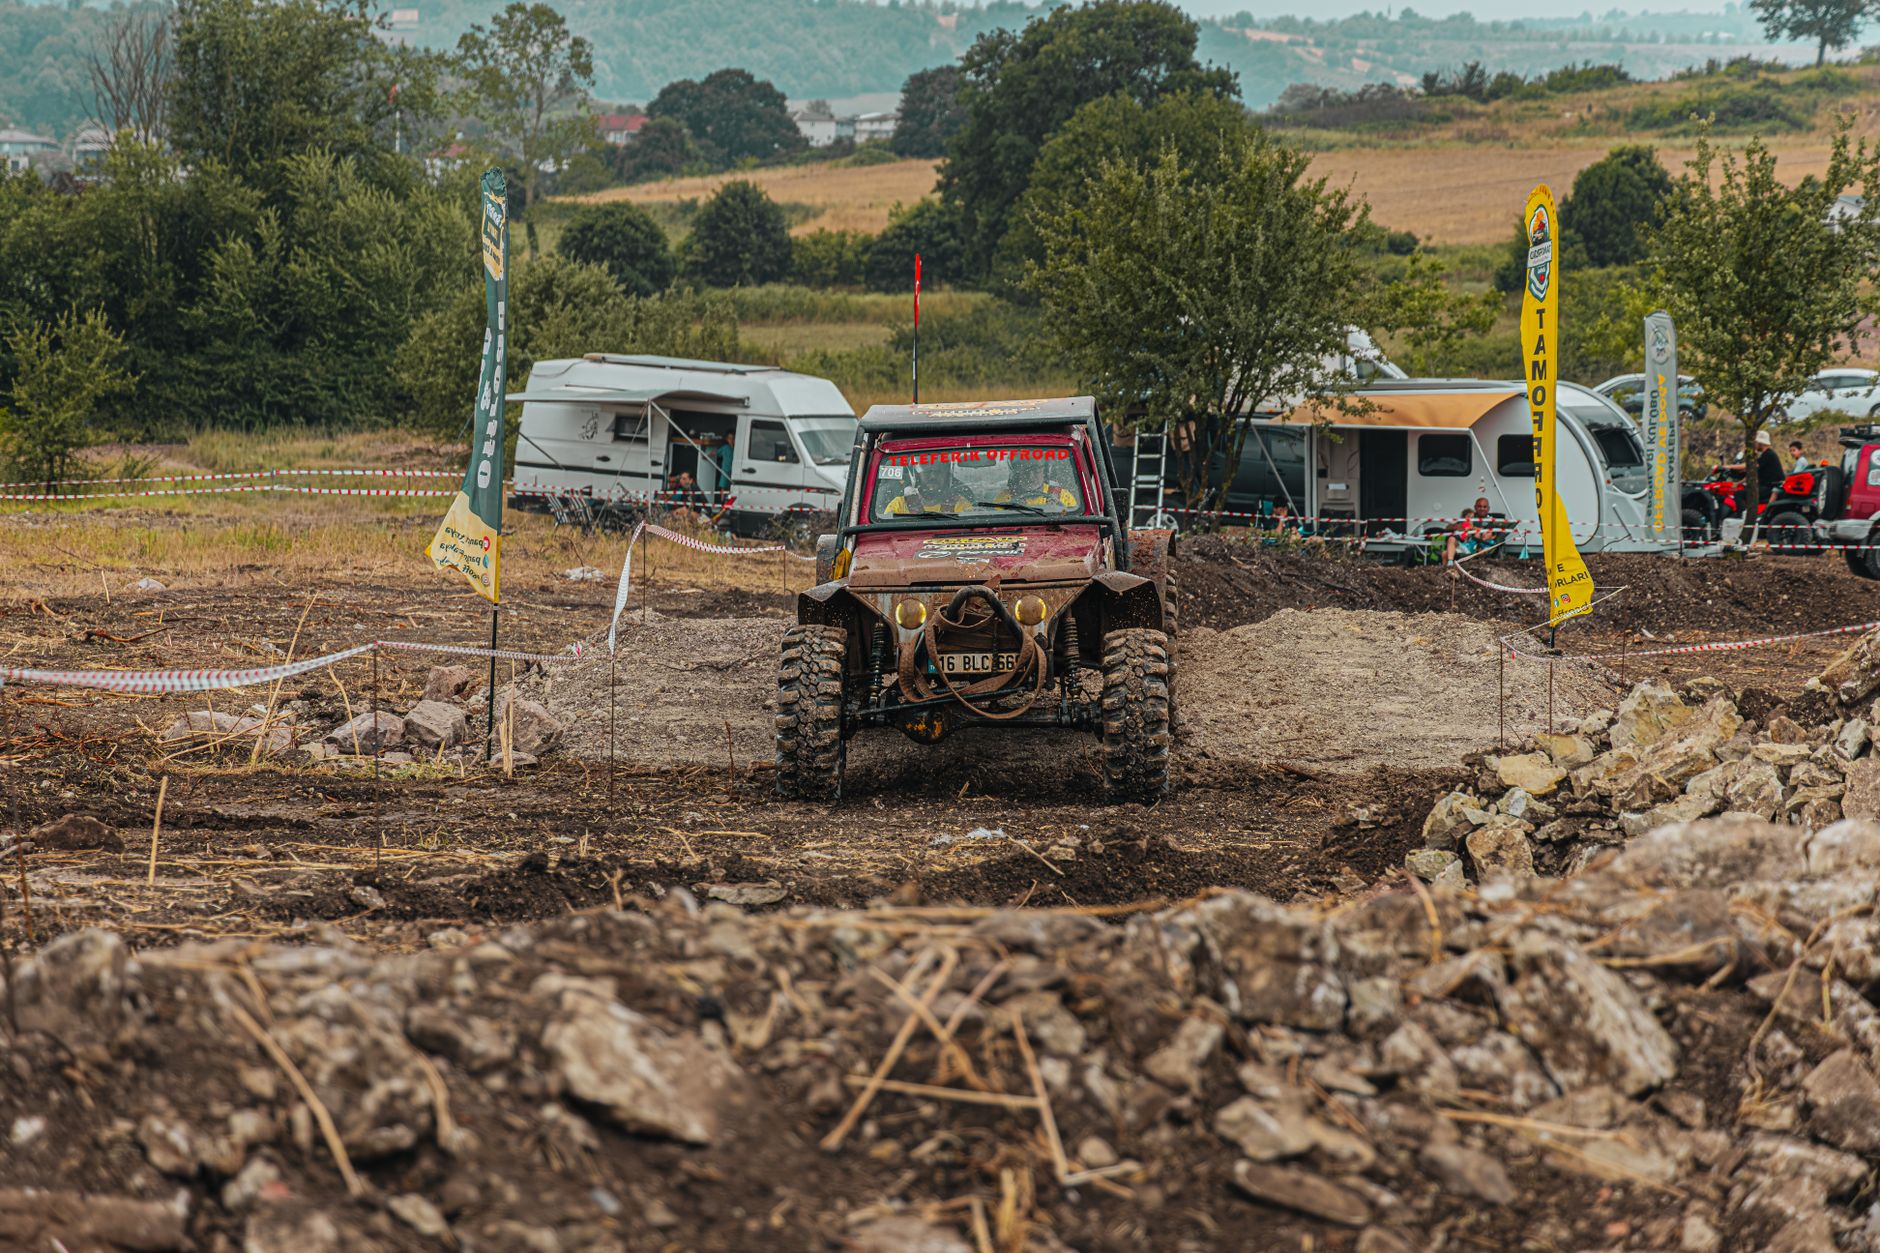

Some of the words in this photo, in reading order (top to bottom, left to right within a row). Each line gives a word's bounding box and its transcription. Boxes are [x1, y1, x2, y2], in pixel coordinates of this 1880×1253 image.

[986, 449, 1069, 462] OFFROAD
[881, 467, 902, 478] 706
[938, 655, 955, 672] 16
[963, 655, 989, 671] BLC
